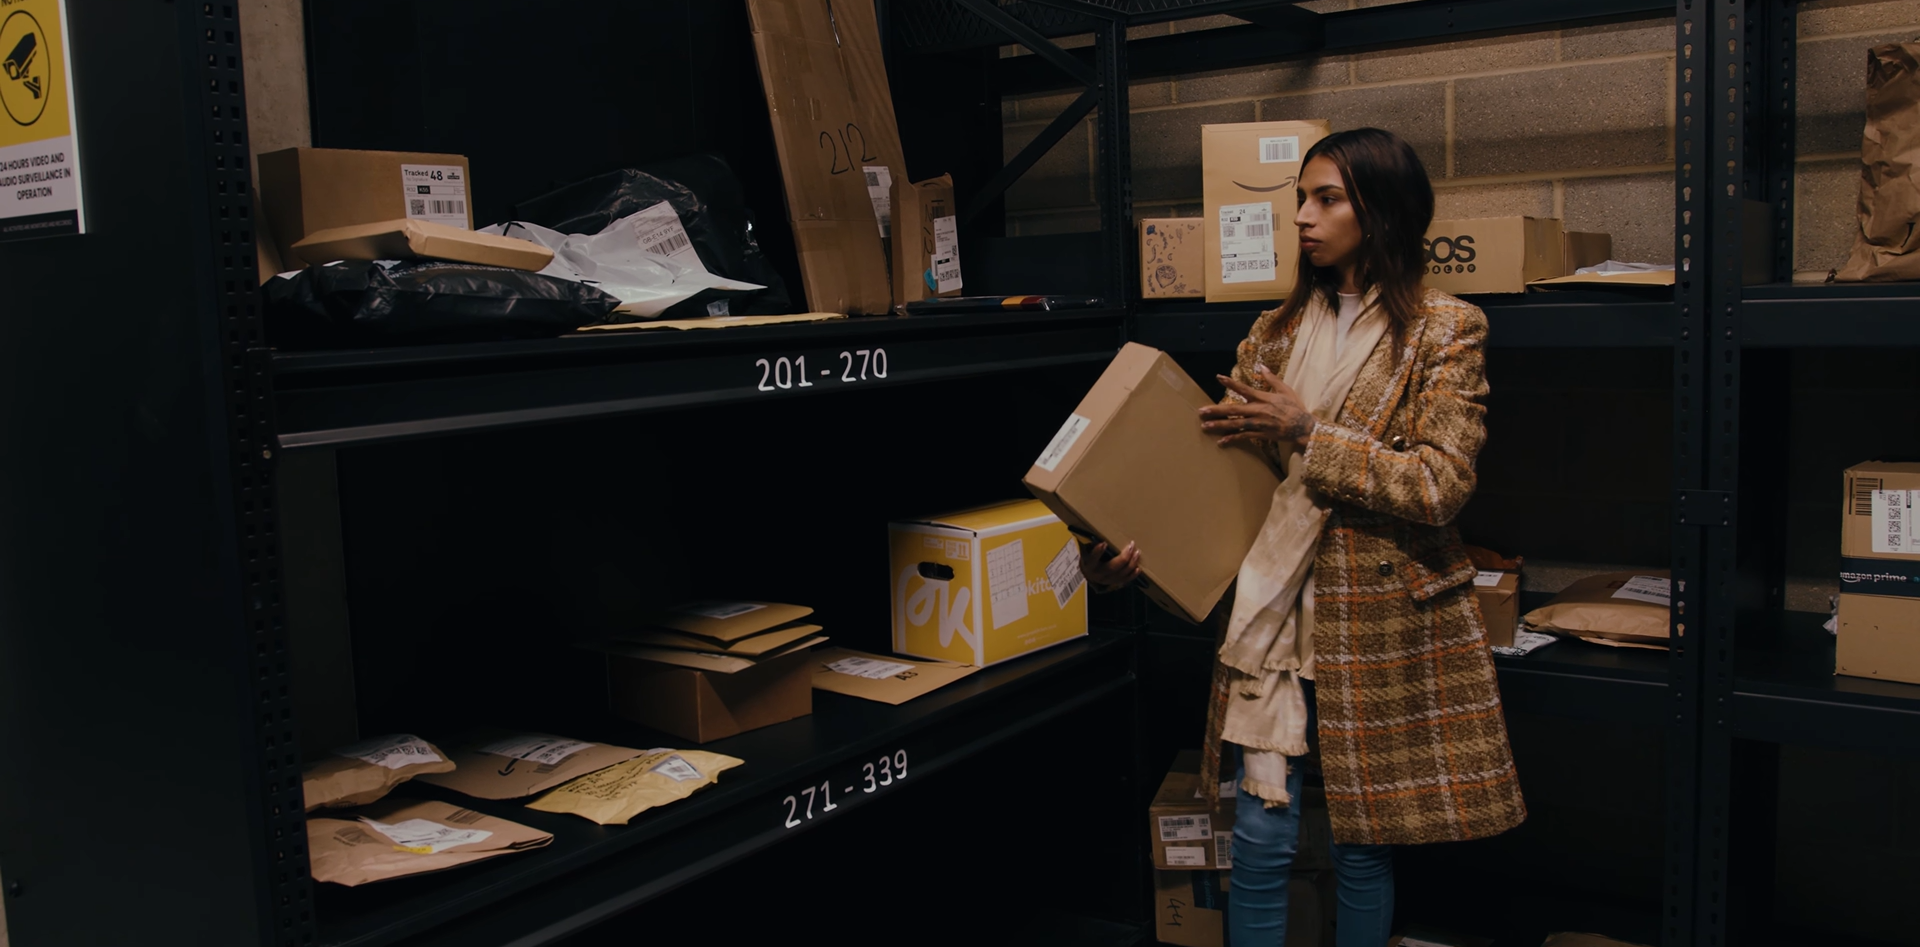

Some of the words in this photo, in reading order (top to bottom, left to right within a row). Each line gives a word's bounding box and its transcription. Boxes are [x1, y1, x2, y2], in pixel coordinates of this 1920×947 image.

[819, 123, 877, 175] 212
[8, 158, 30, 170] HOURS
[30, 155, 49, 167] VIDEO
[50, 152, 65, 163] AND
[18, 169, 63, 184] SURVEILLANCE
[64, 167, 71, 178] IN
[404, 169, 429, 177] Tracked
[430, 170, 443, 181] 48
[17, 187, 52, 200] OPERATION
[755, 354, 813, 391] 201
[839, 348, 888, 382] 270
[1873, 572, 1907, 582] prime
[783, 779, 838, 829] 271
[844, 785, 854, 793] -
[862, 748, 908, 793] 339
